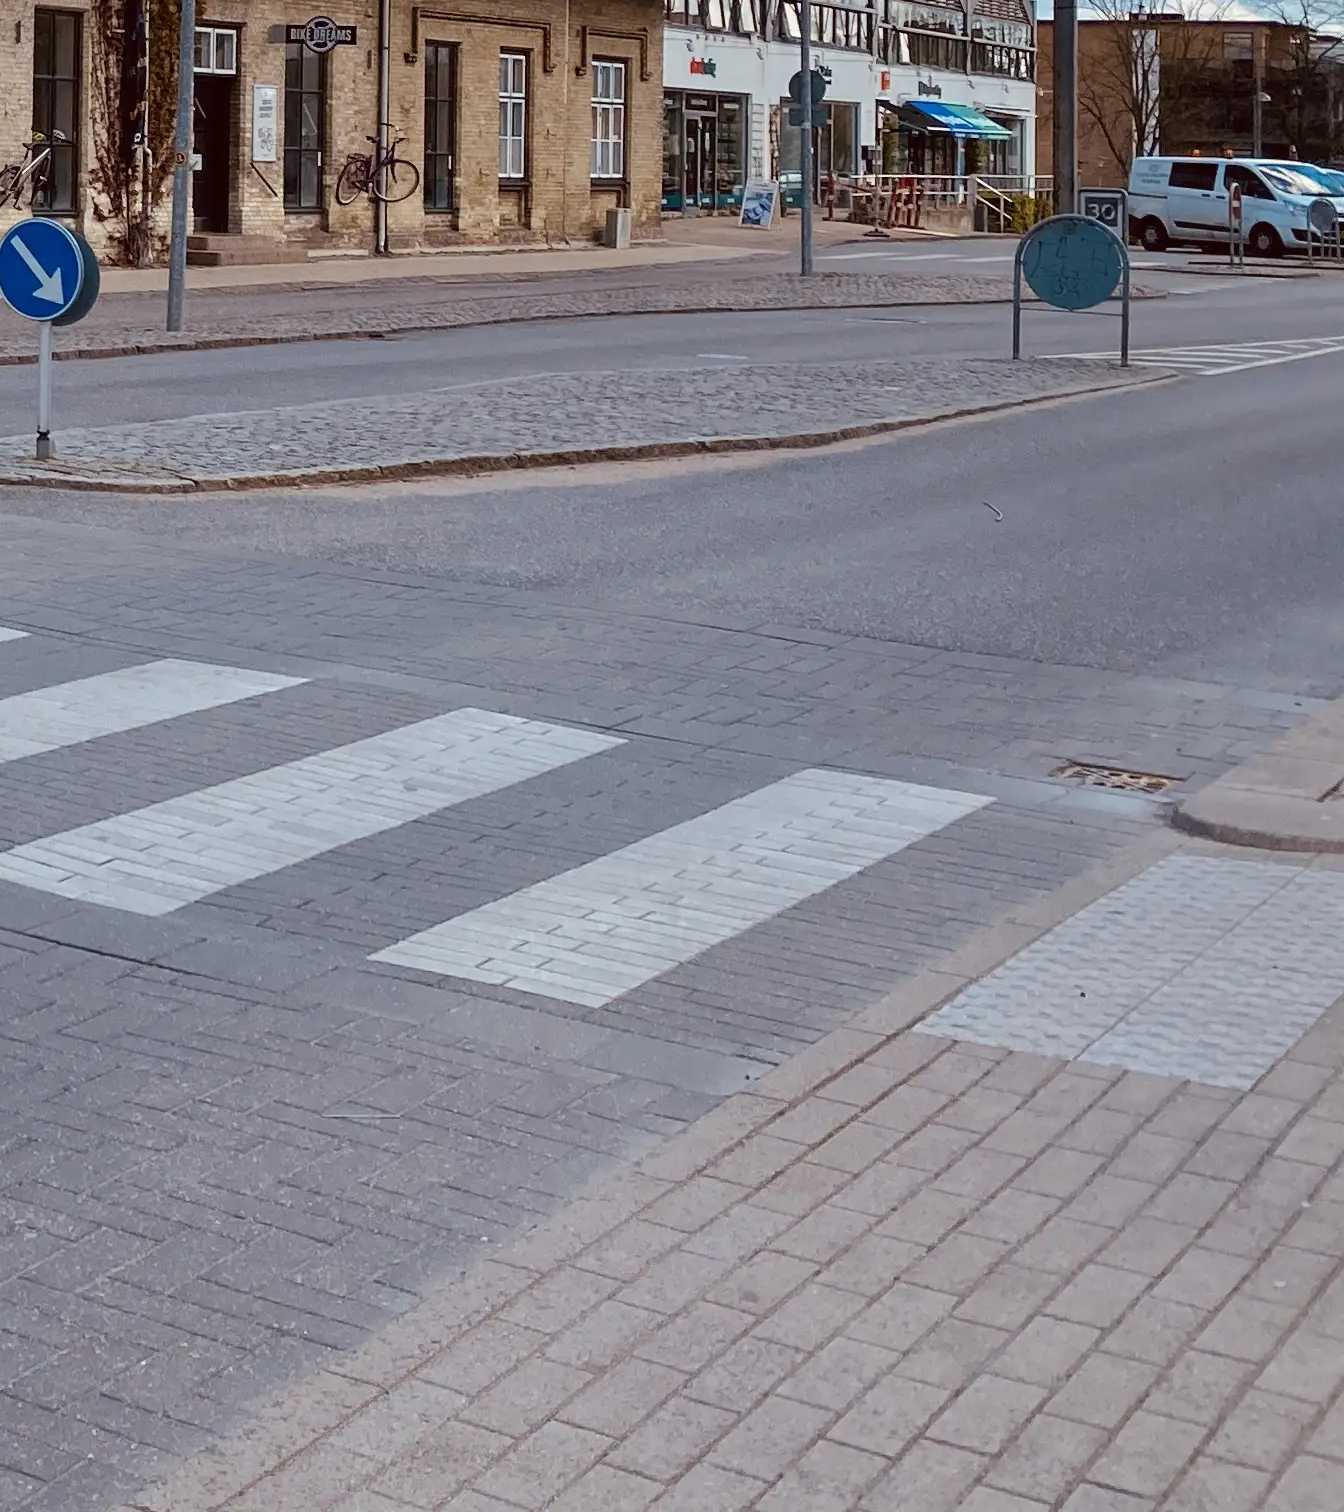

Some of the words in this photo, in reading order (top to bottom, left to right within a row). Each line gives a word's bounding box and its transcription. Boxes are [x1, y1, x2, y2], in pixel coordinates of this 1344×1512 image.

[291, 28, 311, 40] BIKE
[313, 28, 352, 41] DREAMS
[1087, 203, 1116, 220] 30
